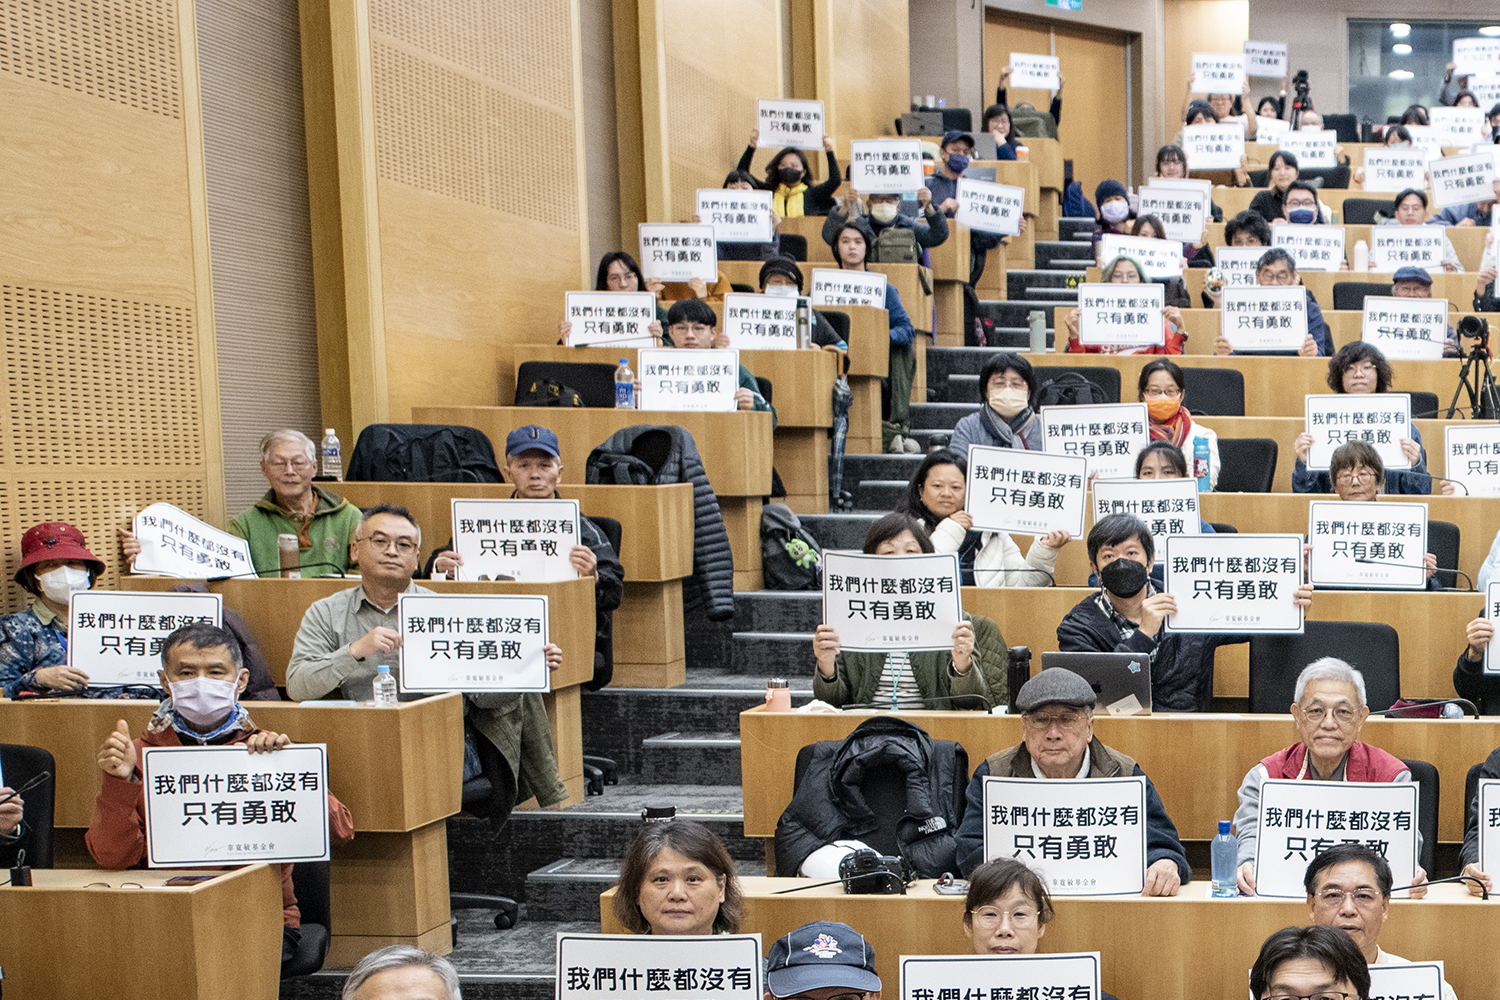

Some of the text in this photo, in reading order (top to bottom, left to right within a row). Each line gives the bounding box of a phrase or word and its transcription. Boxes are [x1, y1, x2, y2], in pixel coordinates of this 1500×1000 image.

[728, 307, 796, 319] 我們什麼都沒
[460, 519, 573, 534] 我們什麼都沒有
[1173, 557, 1295, 573] 我們什麼都沒有
[830, 575, 953, 594] 我們什麼都沒有
[1193, 580, 1278, 600] 只有勇敢
[848, 600, 936, 620] 只有勇敢
[408, 617, 540, 634] 我們什麼都沒有
[430, 640, 521, 660] 只有勇敢
[155, 772, 318, 795] 我們什麼都沒有
[182, 800, 297, 826] 只有勇敢
[991, 805, 1138, 827] 我們什麼都沒有
[1266, 808, 1411, 831] 我們什麼都沒有
[1013, 835, 1117, 859] 只有勇敢
[567, 967, 751, 991] 我們什麼都沒有
